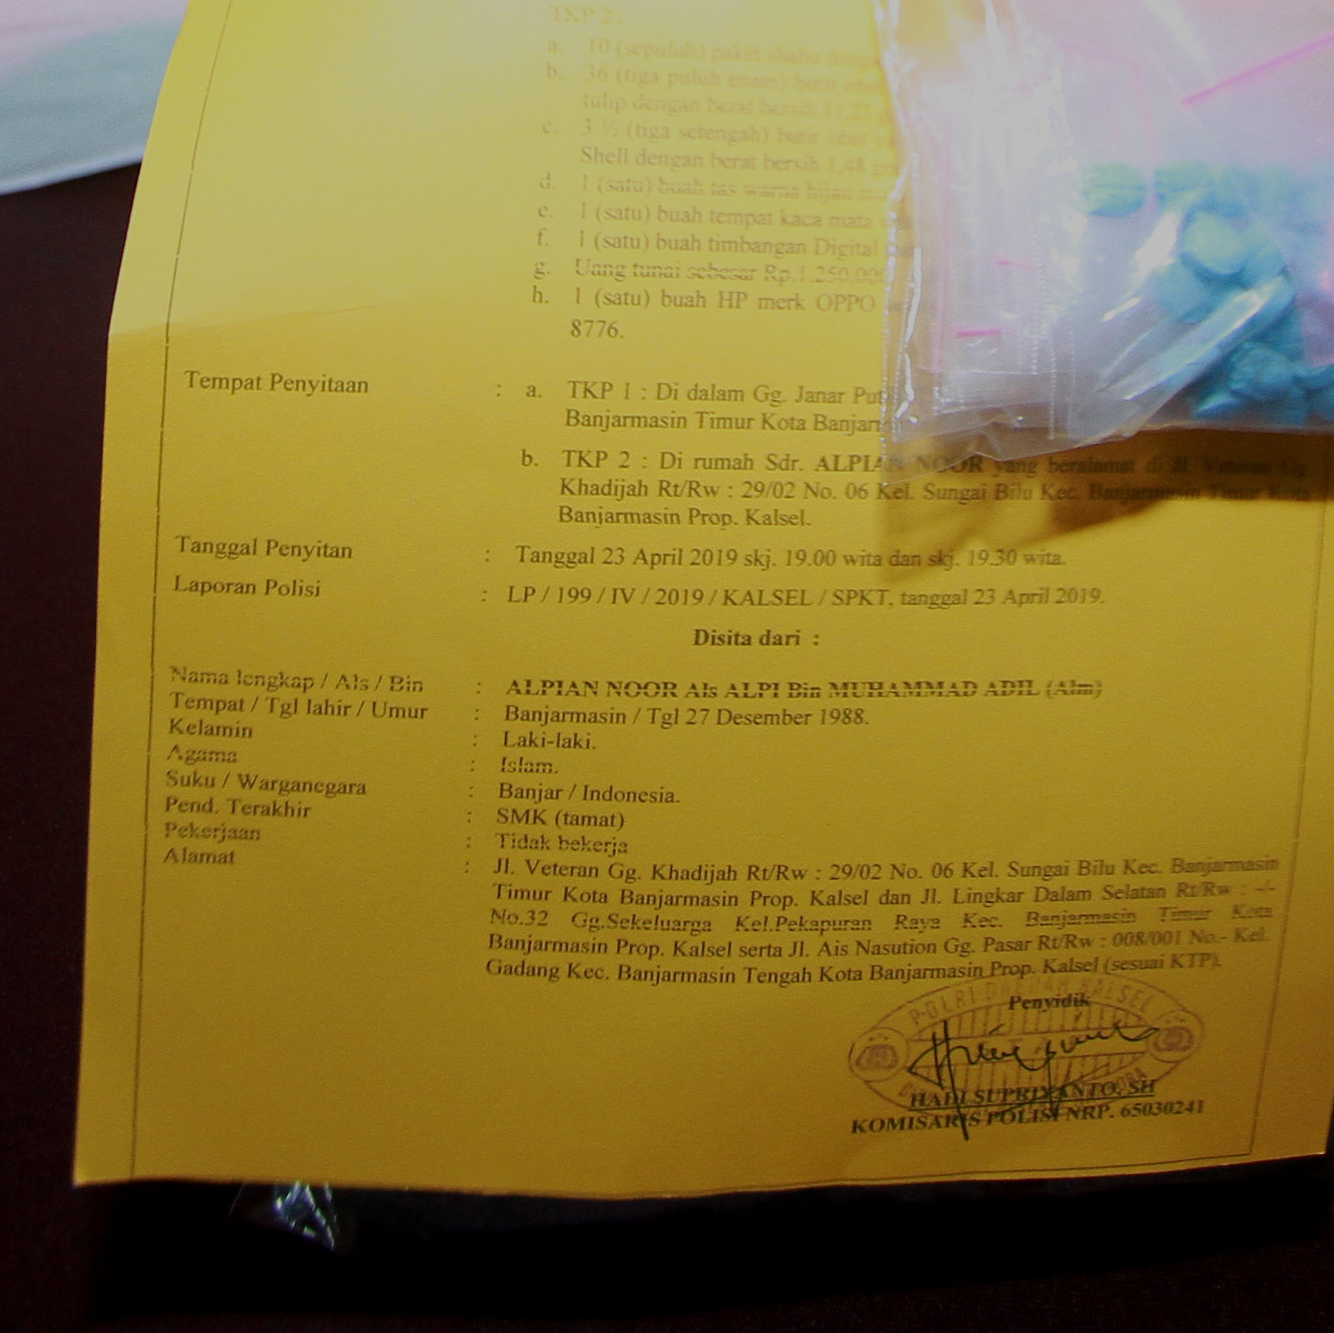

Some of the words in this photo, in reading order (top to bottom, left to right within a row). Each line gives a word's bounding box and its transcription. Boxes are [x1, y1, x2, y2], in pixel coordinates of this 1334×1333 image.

[593, 288, 652, 309] (satu)
[659, 288, 708, 309] buah
[717, 289, 749, 310] HP
[756, 292, 805, 311] merk
[814, 293, 877, 313] OPPO
[569, 318, 624, 339] 8776.
[183, 369, 263, 396] Tempat
[269, 372, 370, 398] Penyitaan
[567, 380, 614, 400] TKP
[655, 381, 680, 402] Di
[685, 382, 746, 403] dalam
[751, 383, 786, 408] Gg.
[794, 384, 847, 405] Janar
[565, 408, 689, 433] Banjarmasin
[693, 410, 755, 431] Timur
[760, 412, 807, 432] Kota
[562, 449, 609, 469] TKP
[659, 450, 684, 470] Di
[692, 452, 755, 472] rumah
[764, 452, 799, 472] Sdr.
[559, 477, 650, 503] Khadijah
[657, 478, 721, 499] Rt/Rw
[741, 479, 797, 500] 29/02
[802, 481, 836, 500] No.
[843, 481, 869, 500] 06
[876, 481, 914, 501] Kel.
[922, 481, 987, 506] Sungai
[993, 481, 1032, 501] Bilu
[1040, 482, 1079, 501] Kec.
[558, 504, 682, 526] Banjarmasin
[687, 506, 738, 528] Prop.
[744, 507, 811, 527] Kalsel.
[174, 534, 259, 561] Tanggal
[264, 538, 354, 563] Penyitan
[512, 544, 596, 570] Tanggal
[601, 546, 626, 566] 23
[632, 547, 684, 571] April
[689, 547, 739, 567] 2019
[743, 548, 777, 573] skj.
[784, 548, 838, 567] 19.00
[842, 549, 885, 568] wita
[888, 548, 921, 568] dan
[927, 549, 960, 573] skj.
[967, 549, 1019, 568] 19.30
[1022, 550, 1067, 568] wita.
[173, 574, 258, 597] Laporan
[264, 578, 321, 598] Polisi
[507, 584, 537, 604] LP
[557, 586, 593, 604] 199
[611, 587, 636, 605] IV
[654, 587, 705, 606] 2019
[722, 588, 812, 607] KALSEL
[831, 588, 894, 608] SPKT,
[899, 587, 969, 611] tanggal
[972, 587, 997, 606] 23
[1001, 586, 1051, 609] April
[1053, 586, 1106, 605] 2019.
[693, 628, 753, 647] Disita
[757, 628, 802, 647] dari
[170, 665, 230, 686] Nama
[236, 668, 316, 695] lengkap
[334, 673, 370, 692] Als
[388, 674, 424, 693] Bin
[506, 678, 599, 698] ALPIAN
[605, 680, 678, 699] NOOR
[684, 681, 719, 699] Als
[724, 681, 780, 700] ALPI
[786, 681, 822, 699] Bin
[828, 679, 979, 699] MUHAMMAD
[983, 678, 1041, 697] ADIL
[169, 691, 246, 717] Tempat
[265, 696, 300, 720] Tgl
[305, 697, 352, 718] lahir
[370, 700, 429, 720] Umur
[504, 704, 628, 728] Banjarmasin
[646, 706, 680, 731] Tgl
[685, 707, 710, 726] 27
[715, 707, 813, 727] Desember
[819, 707, 869, 726] 1988.
[168, 717, 254, 740] Kelamin
[502, 729, 596, 750] Laki-laki.
[166, 743, 239, 767] Agama
[165, 769, 217, 789] Suku
[236, 772, 368, 800] Warganegara
[498, 781, 564, 805] Banjar
[582, 783, 680, 805] Indonesia.
[164, 795, 220, 815] Pend.
[225, 797, 312, 819] Terakhir
[496, 807, 548, 826] SMK
[554, 809, 626, 832] (tamat)
[163, 820, 262, 845] Pekerjaan
[163, 846, 236, 866] Alamat
[495, 832, 552, 851] Tidak
[557, 834, 629, 859] bekerja
[493, 857, 515, 875] Jl.
[525, 858, 601, 879] Veteran
[606, 861, 642, 885] Gg.
[650, 863, 739, 887] Khadijah
[745, 863, 808, 882] Rt/Rw
[829, 862, 883, 881] 29/02
[889, 862, 923, 881] No.
[929, 861, 955, 880] 06
[961, 860, 999, 879] Kel.
[1006, 859, 1071, 883] Sungai
[1075, 858, 1117, 877] Bilu
[1121, 857, 1164, 876] Kec.
[491, 882, 553, 902] Timur
[562, 885, 610, 905] Kota
[618, 887, 740, 912] Banjarmasin
[749, 889, 798, 912] Prop.
[809, 888, 869, 907] Kalsel
[877, 887, 913, 906] dan
[919, 887, 941, 906] Jl.
[951, 886, 1026, 909] Lingkar
[1032, 885, 1093, 904] Dalam
[1100, 883, 1168, 901] Selatan
[489, 907, 549, 927] No.32
[570, 911, 713, 938] Gg.Sekeluarga
[893, 913, 942, 935] Raya
[1024, 907, 1138, 931] Banjarmasin
[1155, 905, 1213, 923] Timur
[488, 932, 609, 957] Banjarmasin
[615, 937, 665, 962] Prop.
[672, 939, 733, 959] Kalsel
[738, 943, 784, 959] serta
[787, 939, 810, 959] Jl.
[816, 939, 849, 958] Ais
[854, 937, 938, 957] Nasution
[941, 936, 975, 959] Gg.
[982, 935, 1034, 953] Pasar
[1036, 933, 1095, 952] Rt/Rw
[1110, 929, 1182, 948] 008/001
[485, 958, 561, 984] Gadang
[566, 961, 610, 981] Kec.
[617, 963, 737, 988] Banjarmasin
[738, 965, 813, 989] Tengah
[818, 965, 864, 983] Kota
[869, 961, 985, 985] Banjarmasin
[988, 960, 1037, 981] Prop.
[1041, 955, 1100, 975] Kalsel
[1007, 992, 1092, 1013] Penyidik
[1128, 1079, 1156, 1095] SH
[1066, 1104, 1116, 1121] NRP.
[1120, 1100, 1205, 1118] 65030241
